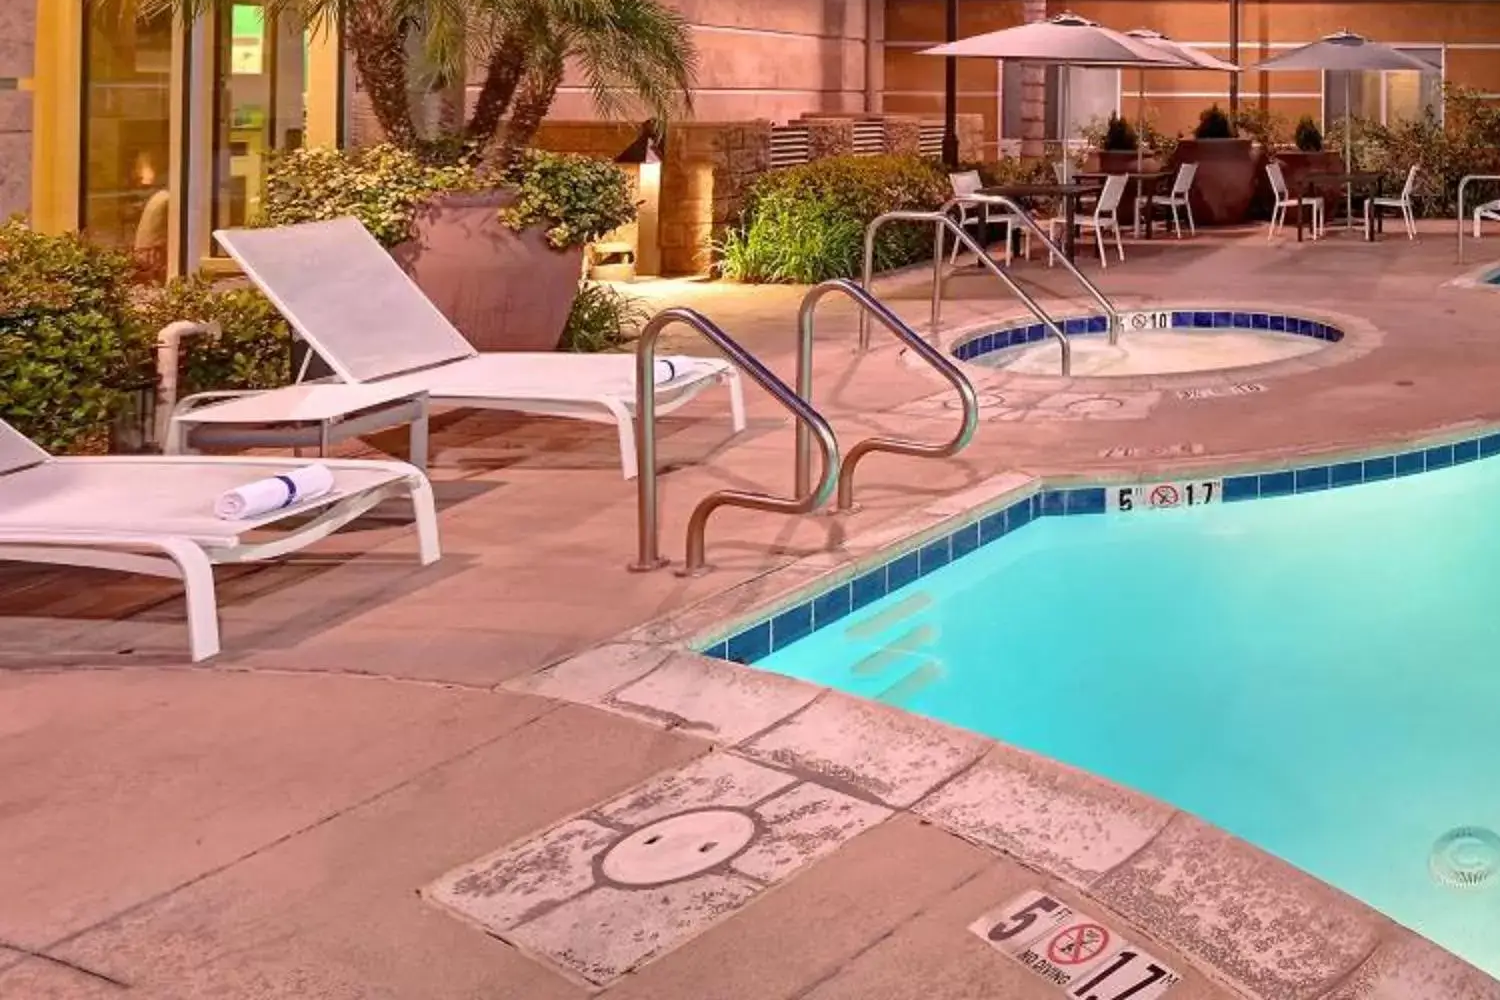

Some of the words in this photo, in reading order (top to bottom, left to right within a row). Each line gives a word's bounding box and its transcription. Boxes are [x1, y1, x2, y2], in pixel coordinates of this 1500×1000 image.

[1119, 487, 1133, 511] 5
[987, 896, 1060, 942] 5
[1016, 948, 1038, 967] NO
[1033, 958, 1072, 985] DIVING
